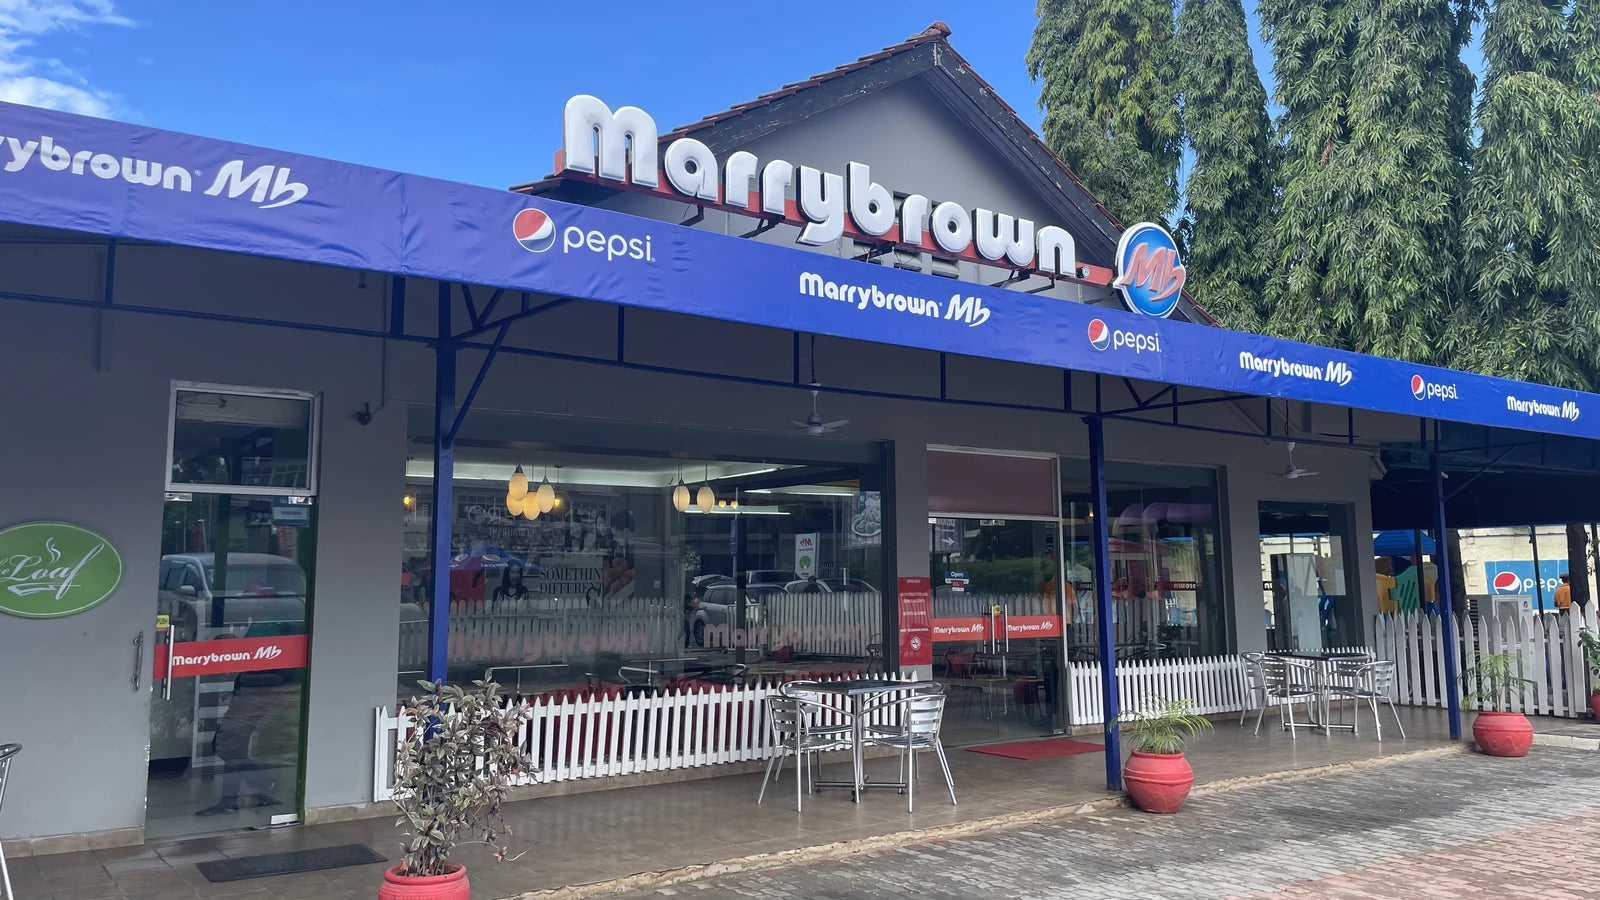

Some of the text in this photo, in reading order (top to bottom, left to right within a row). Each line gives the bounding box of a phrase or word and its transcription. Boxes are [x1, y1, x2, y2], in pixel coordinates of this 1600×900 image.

[0, 135, 309, 209] ybrown Mb
[564, 93, 1185, 302] Marrybrown Mb
[563, 225, 651, 261] pepsi
[799, 271, 991, 328] Marrybrown Mb
[1113, 329, 1160, 354] pepsi
[1239, 351, 1353, 387] Marrybrown Mb
[1427, 382, 1457, 402] pepsi
[1506, 395, 1580, 422] Marrybrown Mb
[9, 543, 104, 600] Loaf
[539, 567, 603, 581] SOMETHIN
[933, 626, 970, 635] Marrybrown
[172, 645, 282, 666] Marrybrown Mb
